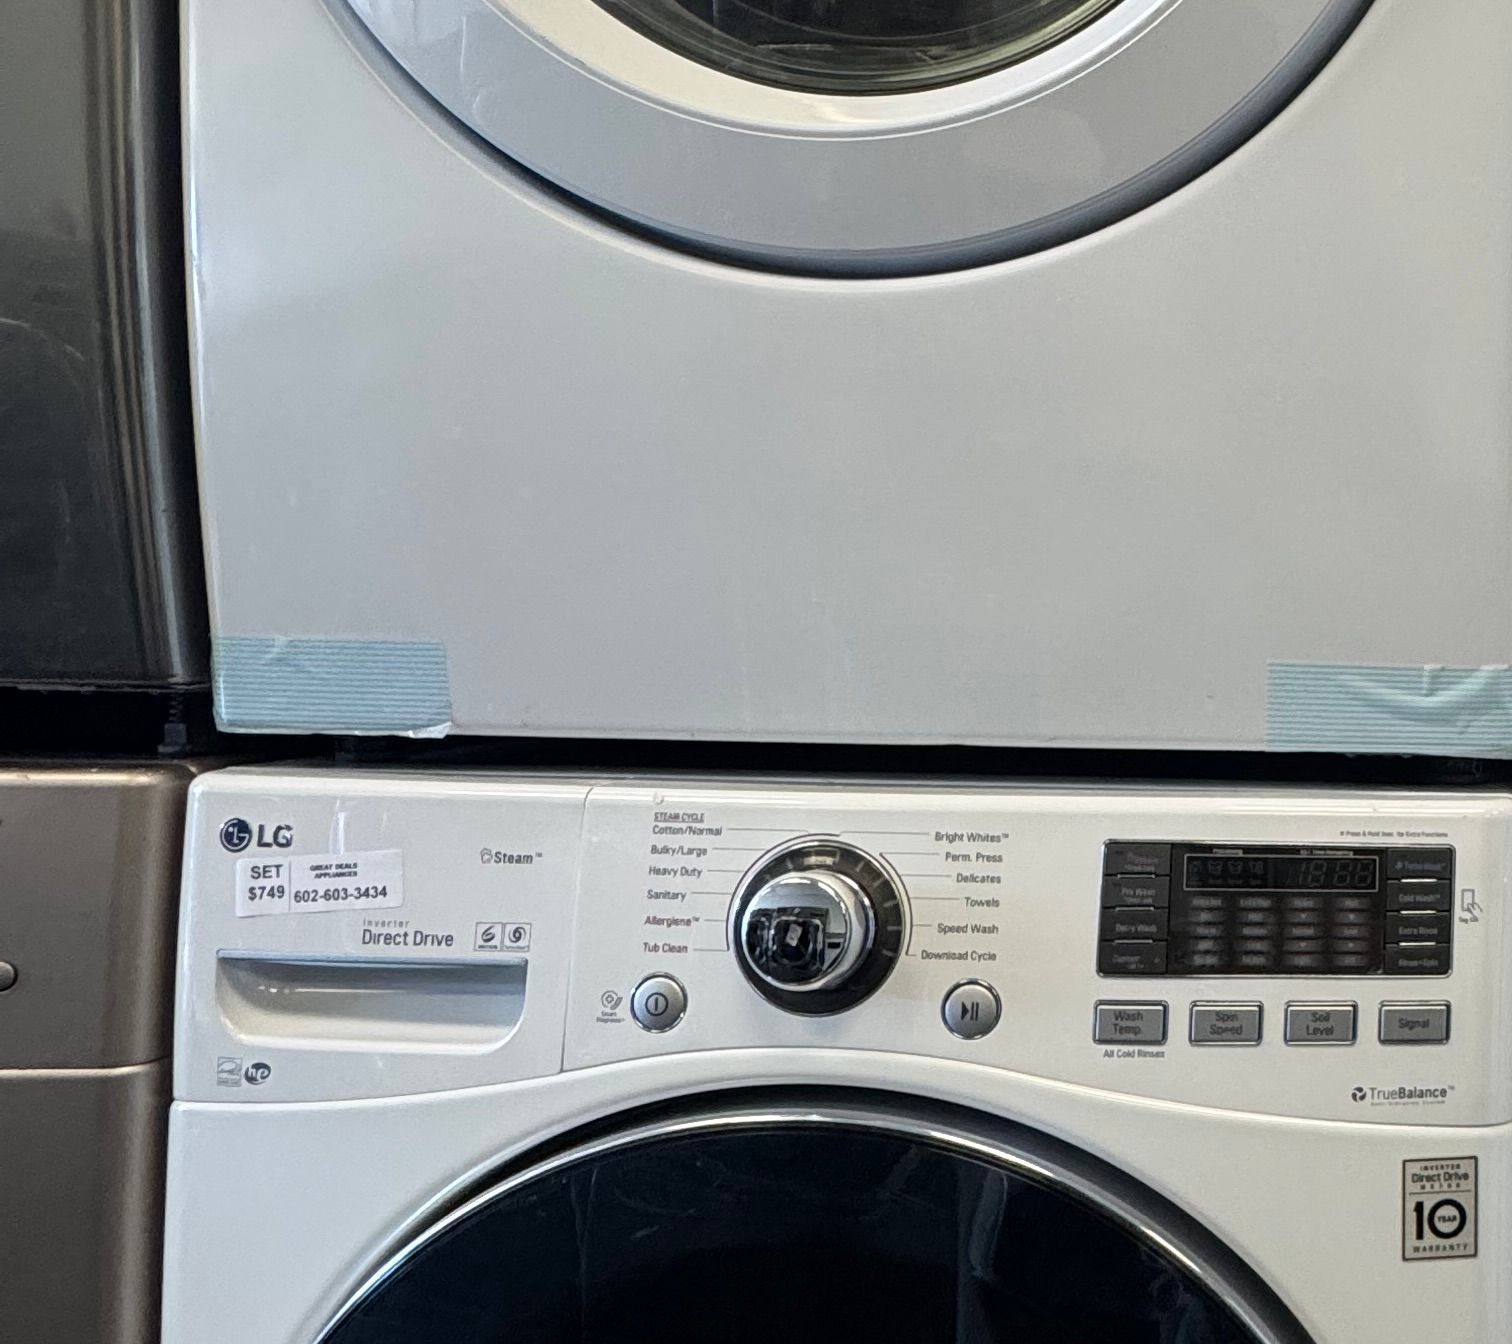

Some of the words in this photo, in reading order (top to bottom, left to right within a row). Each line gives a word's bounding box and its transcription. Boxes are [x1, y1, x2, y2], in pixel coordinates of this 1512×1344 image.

[654, 812, 680, 821] STEAM
[681, 812, 705, 821] CYCLE
[256, 824, 294, 848] LG
[652, 824, 723, 837] Cotton/Normal
[934, 831, 965, 844] Bright
[650, 844, 708, 858] Bulky/Large
[945, 851, 973, 862] Perm.
[975, 852, 1003, 863] Press
[250, 864, 284, 880] SET
[309, 863, 332, 871] GREAT
[335, 862, 358, 870] DEALS
[648, 865, 678, 878] Heavy
[680, 865, 703, 878] Duty
[314, 871, 358, 879] APPLIANCES
[956, 872, 1002, 884] Delicates
[247, 885, 285, 901] $749
[294, 885, 388, 903] 602-603-3434
[646, 889, 687, 903] Sanitary
[964, 896, 1000, 908] Towels
[937, 922, 969, 935] Speed
[970, 923, 999, 934] Wash
[361, 928, 409, 946] Direct
[413, 930, 454, 947] Drive
[643, 942, 660, 953] Tub
[661, 942, 688, 954] Clean
[920, 949, 969, 961] Download
[970, 950, 997, 963] Cycle
[1113, 1010, 1144, 1022] Wash
[1215, 1011, 1239, 1023] Spin
[1311, 1011, 1330, 1023] Soil
[1209, 1024, 1243, 1037] Speed
[1306, 1024, 1334, 1037] Level
[1398, 1017, 1430, 1031] Signal
[1103, 1049, 1115, 1058] All
[1116, 1049, 1135, 1058] Cold
[1137, 1049, 1166, 1058] Rinses
[1419, 1163, 1461, 1172] INVERTER
[1411, 1172, 1441, 1184] Direct
[1443, 1171, 1469, 1182] Drive
[1413, 1198, 1467, 1240] 10
[1437, 1214, 1457, 1223] YEAR
[1412, 1243, 1468, 1253] WARRANTY
